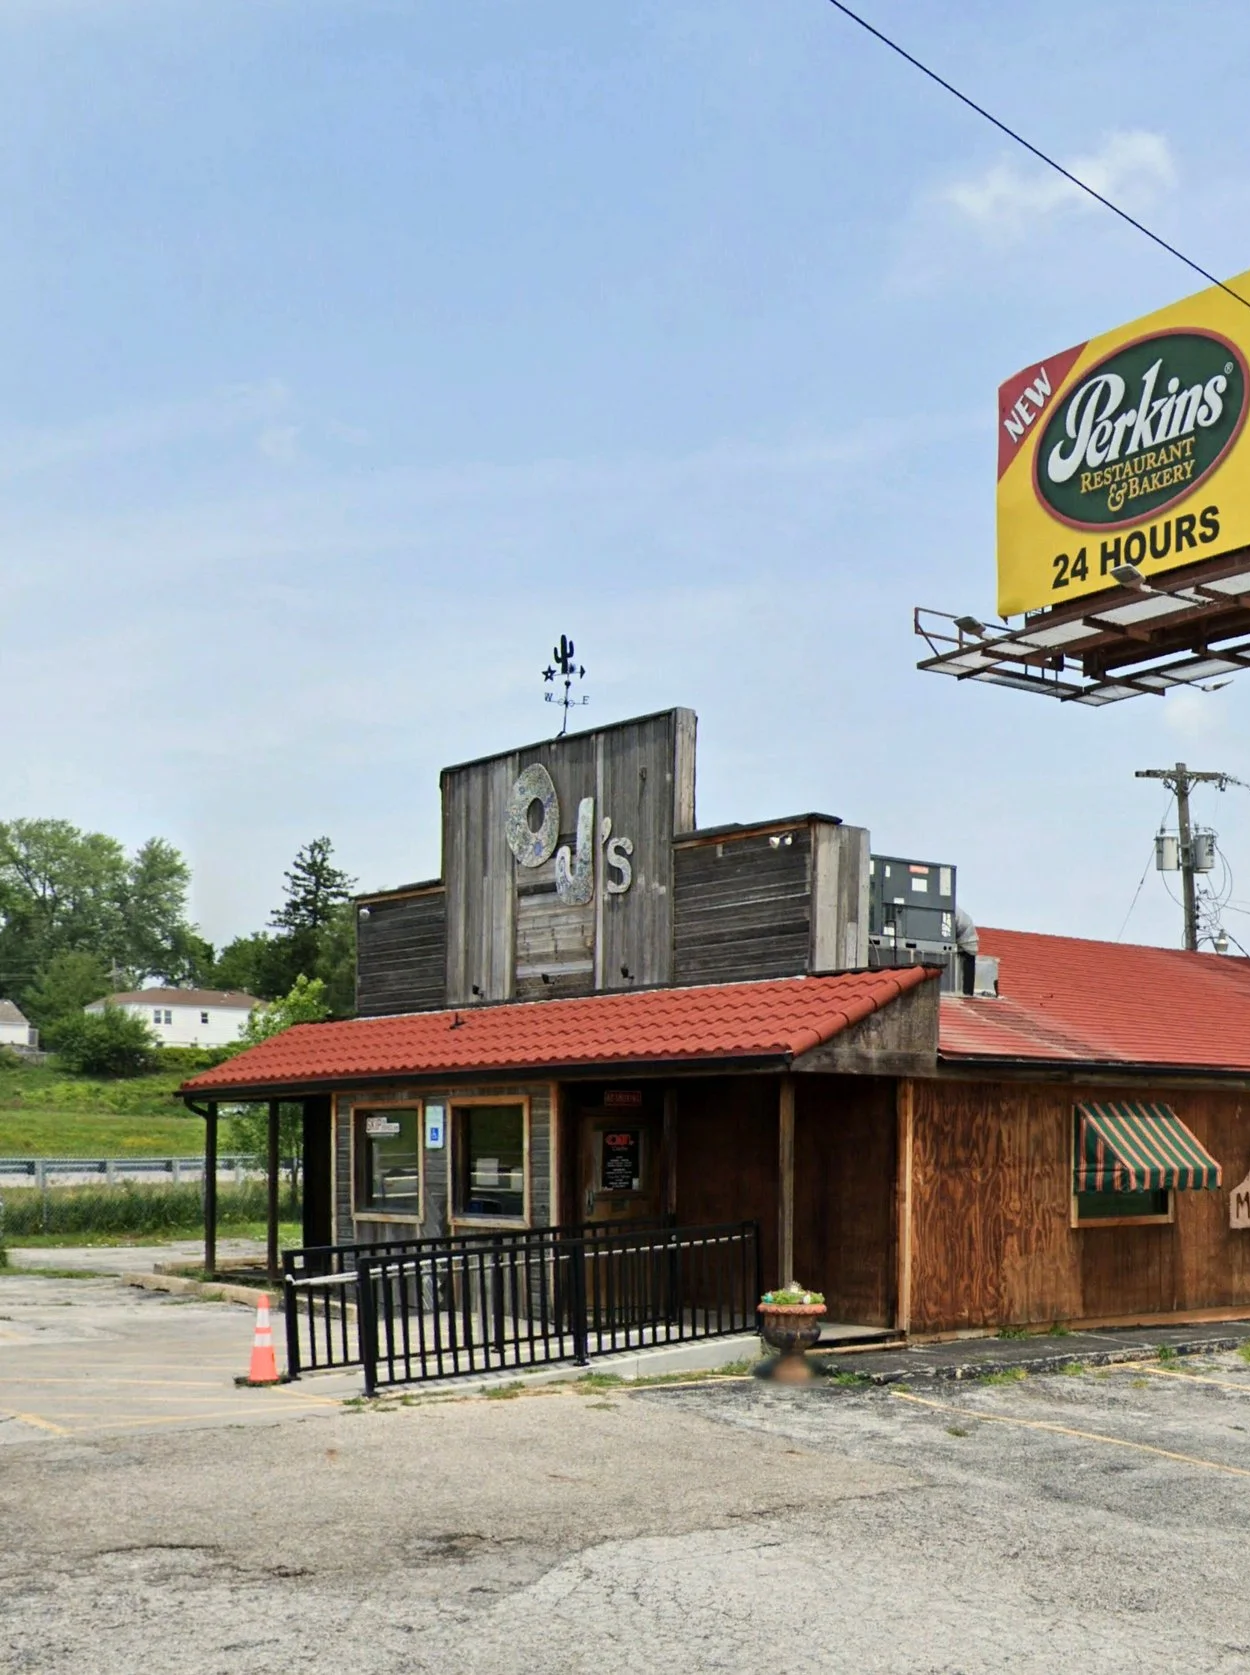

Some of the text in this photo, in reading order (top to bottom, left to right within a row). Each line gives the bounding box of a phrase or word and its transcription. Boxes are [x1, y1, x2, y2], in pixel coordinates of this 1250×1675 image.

[1003, 366, 1053, 443] NEW
[1047, 357, 1228, 484] Perkins
[1080, 436, 1196, 494] RESTAURANT
[1051, 547, 1089, 590] 24
[1100, 505, 1221, 576] HOURS
